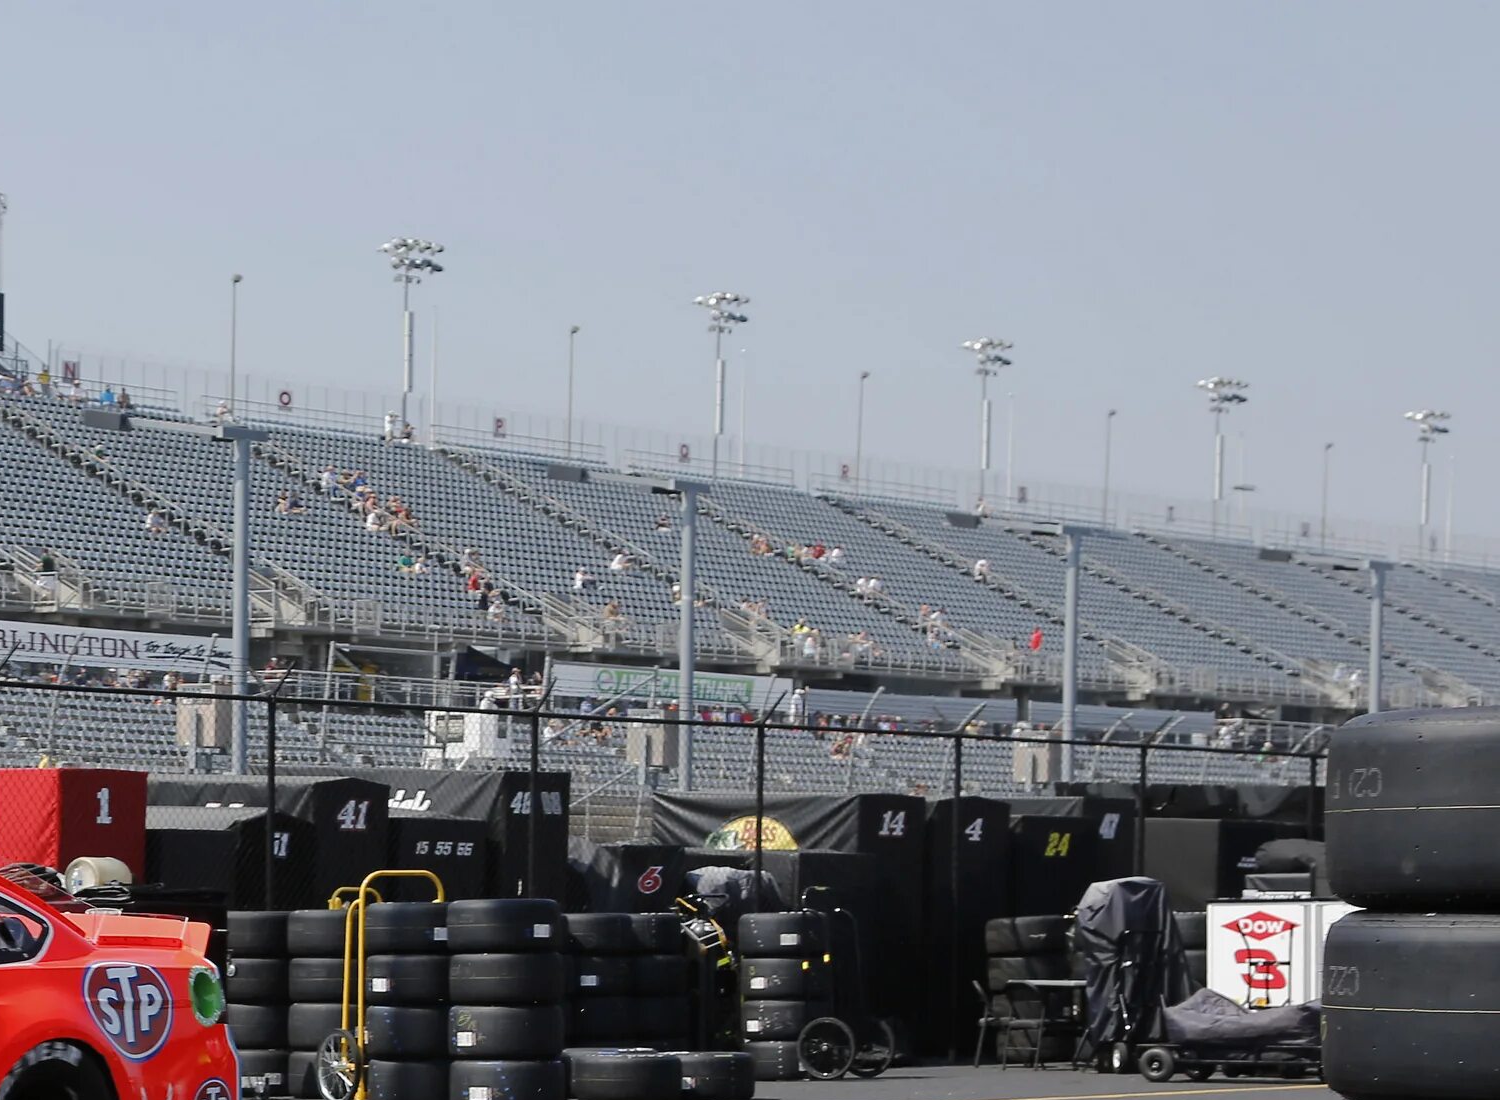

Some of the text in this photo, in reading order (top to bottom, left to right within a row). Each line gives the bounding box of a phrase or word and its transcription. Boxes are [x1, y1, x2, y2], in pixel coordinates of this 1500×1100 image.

[64, 362, 77, 382] N
[496, 418, 504, 433] P
[96, 787, 112, 824] 1
[336, 800, 371, 829] 41
[879, 811, 906, 836] 14
[965, 817, 982, 841] 4
[1045, 833, 1071, 857] 24
[638, 866, 663, 894] 6
[1238, 919, 1285, 934] DOW
[1234, 948, 1287, 990] 3
[97, 966, 164, 1043] STP
